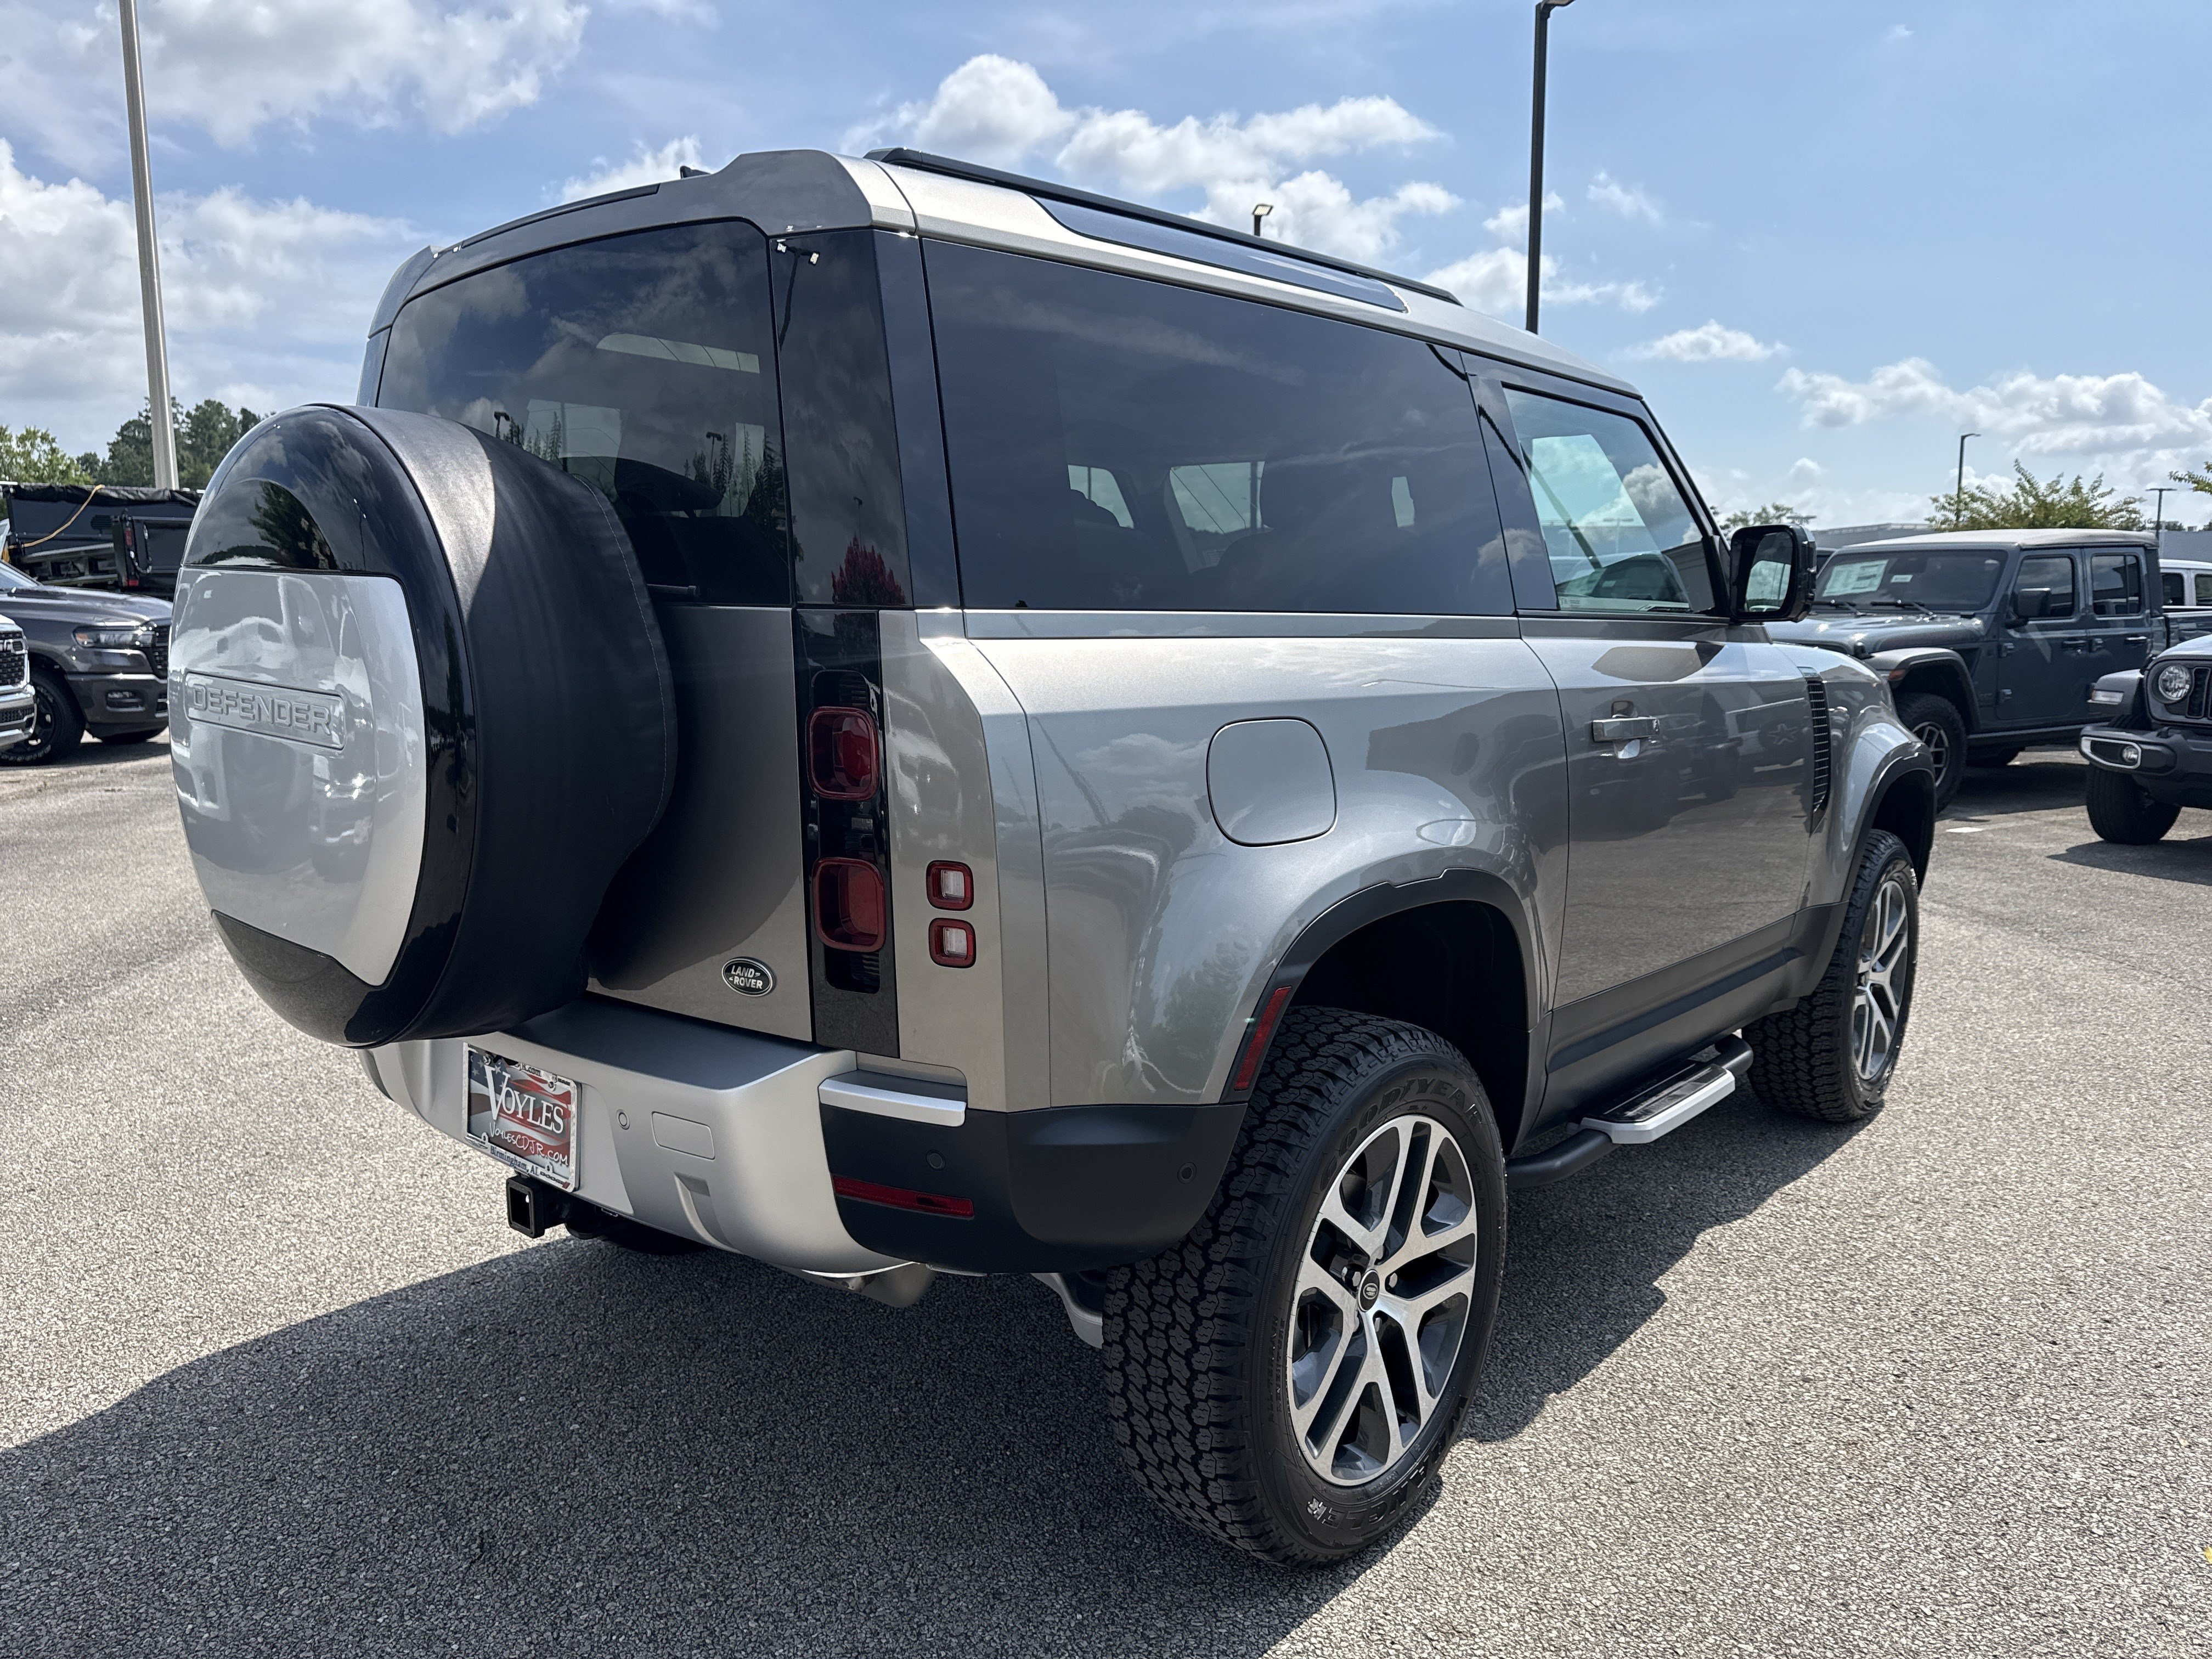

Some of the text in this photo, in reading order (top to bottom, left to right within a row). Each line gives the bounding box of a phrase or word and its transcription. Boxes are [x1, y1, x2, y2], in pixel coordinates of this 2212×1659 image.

[192, 683, 331, 736] DEFENDER
[731, 965, 755, 978] LAND
[733, 975, 763, 989] ROVER
[484, 1064, 564, 1134] VOYLES
[1320, 1077, 1482, 1192] GOODYEAR
